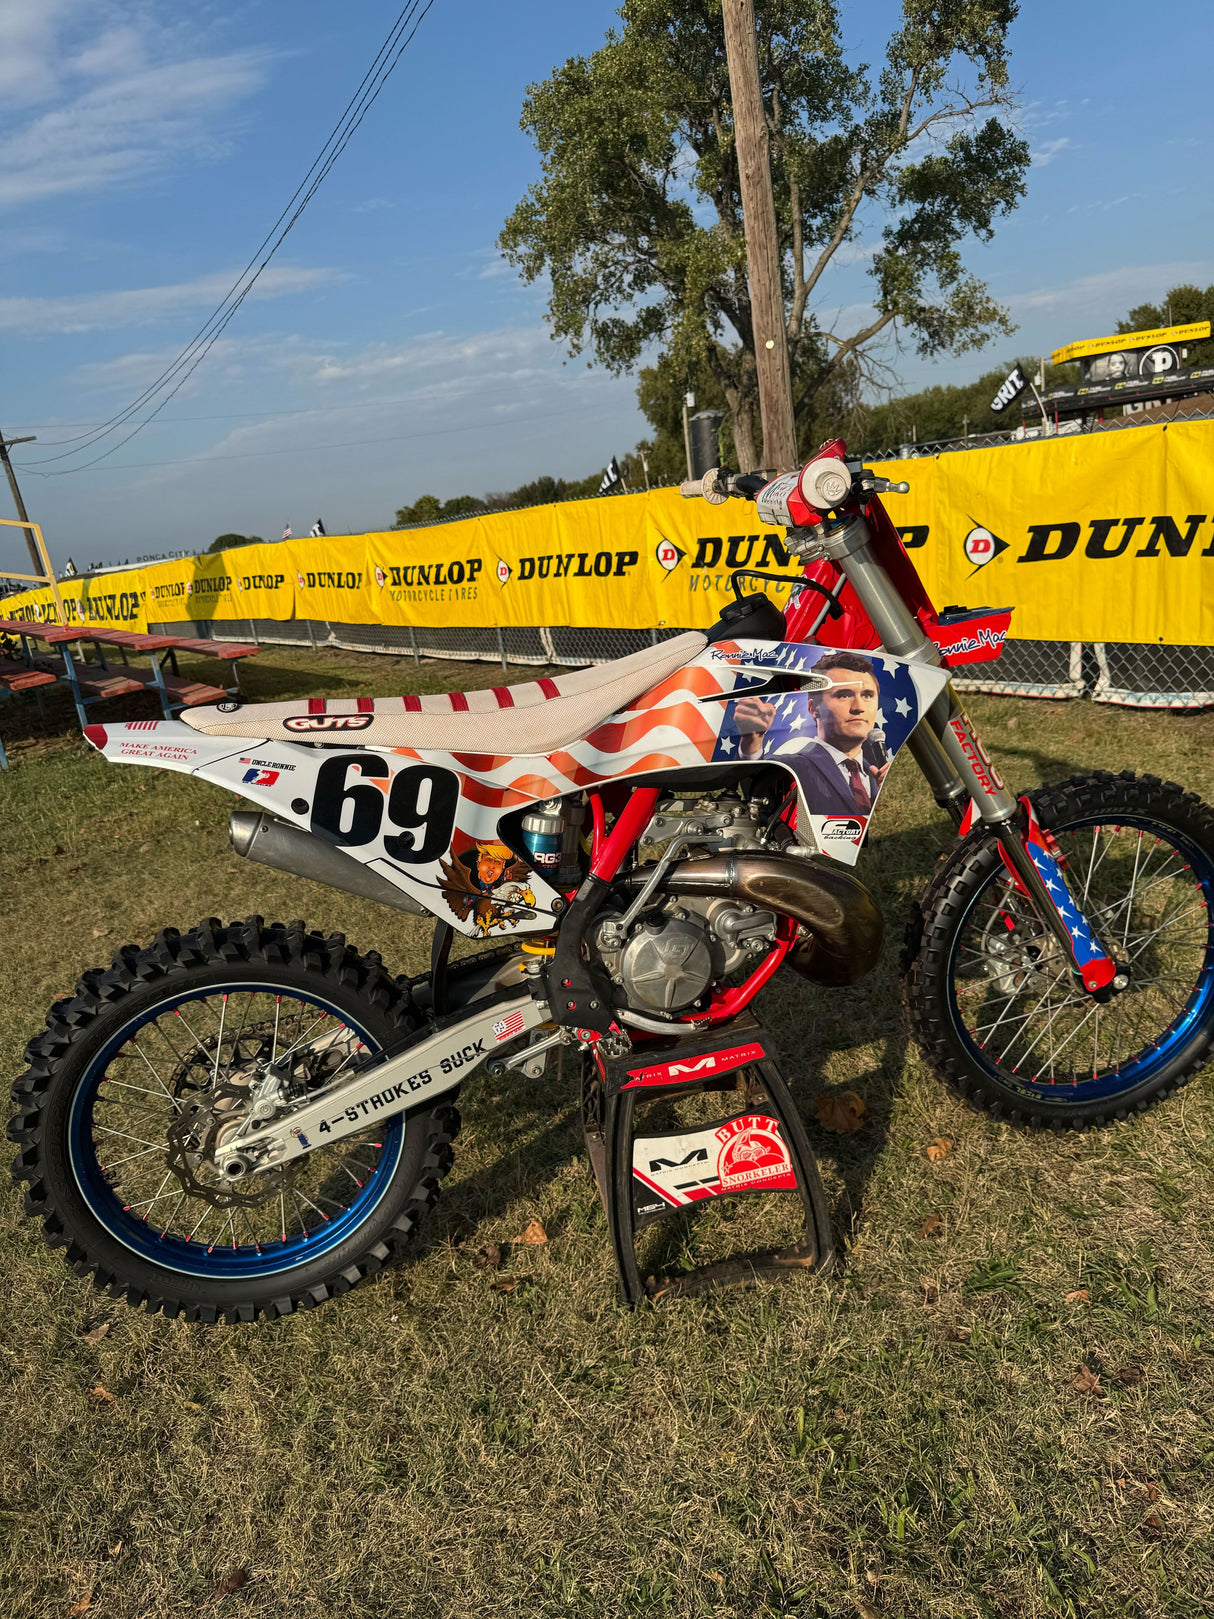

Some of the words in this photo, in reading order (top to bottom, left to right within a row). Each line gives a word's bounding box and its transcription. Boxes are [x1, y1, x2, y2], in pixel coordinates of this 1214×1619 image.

[1016, 514, 1214, 563] DUN
[136, 553, 167, 563] PONCA
[518, 551, 639, 580] DUNLOP
[389, 558, 482, 587] DUNLOP
[194, 576, 232, 594] DUNLOP
[390, 588, 445, 602] MOTORCYCLE
[711, 648, 751, 660] Ronnie
[286, 716, 370, 730] GUTS
[120, 742, 150, 750] MAKE
[150, 745, 197, 755] AMERICA
[121, 749, 155, 757] GREAT
[949, 719, 997, 796] FACTORY
[251, 759, 272, 767] UNCLE
[271, 762, 296, 771] RONNIE
[310, 754, 459, 864] 69
[721, 1049, 756, 1062] MATRIX
[318, 1069, 433, 1134] 4-STROKES
[439, 1038, 487, 1075] SUCK
[717, 1117, 778, 1142] BUTT
[721, 1182, 748, 1192] MATRIX
[751, 1173, 792, 1185] CONCEPTS
[722, 1164, 790, 1187] SNORKELER
